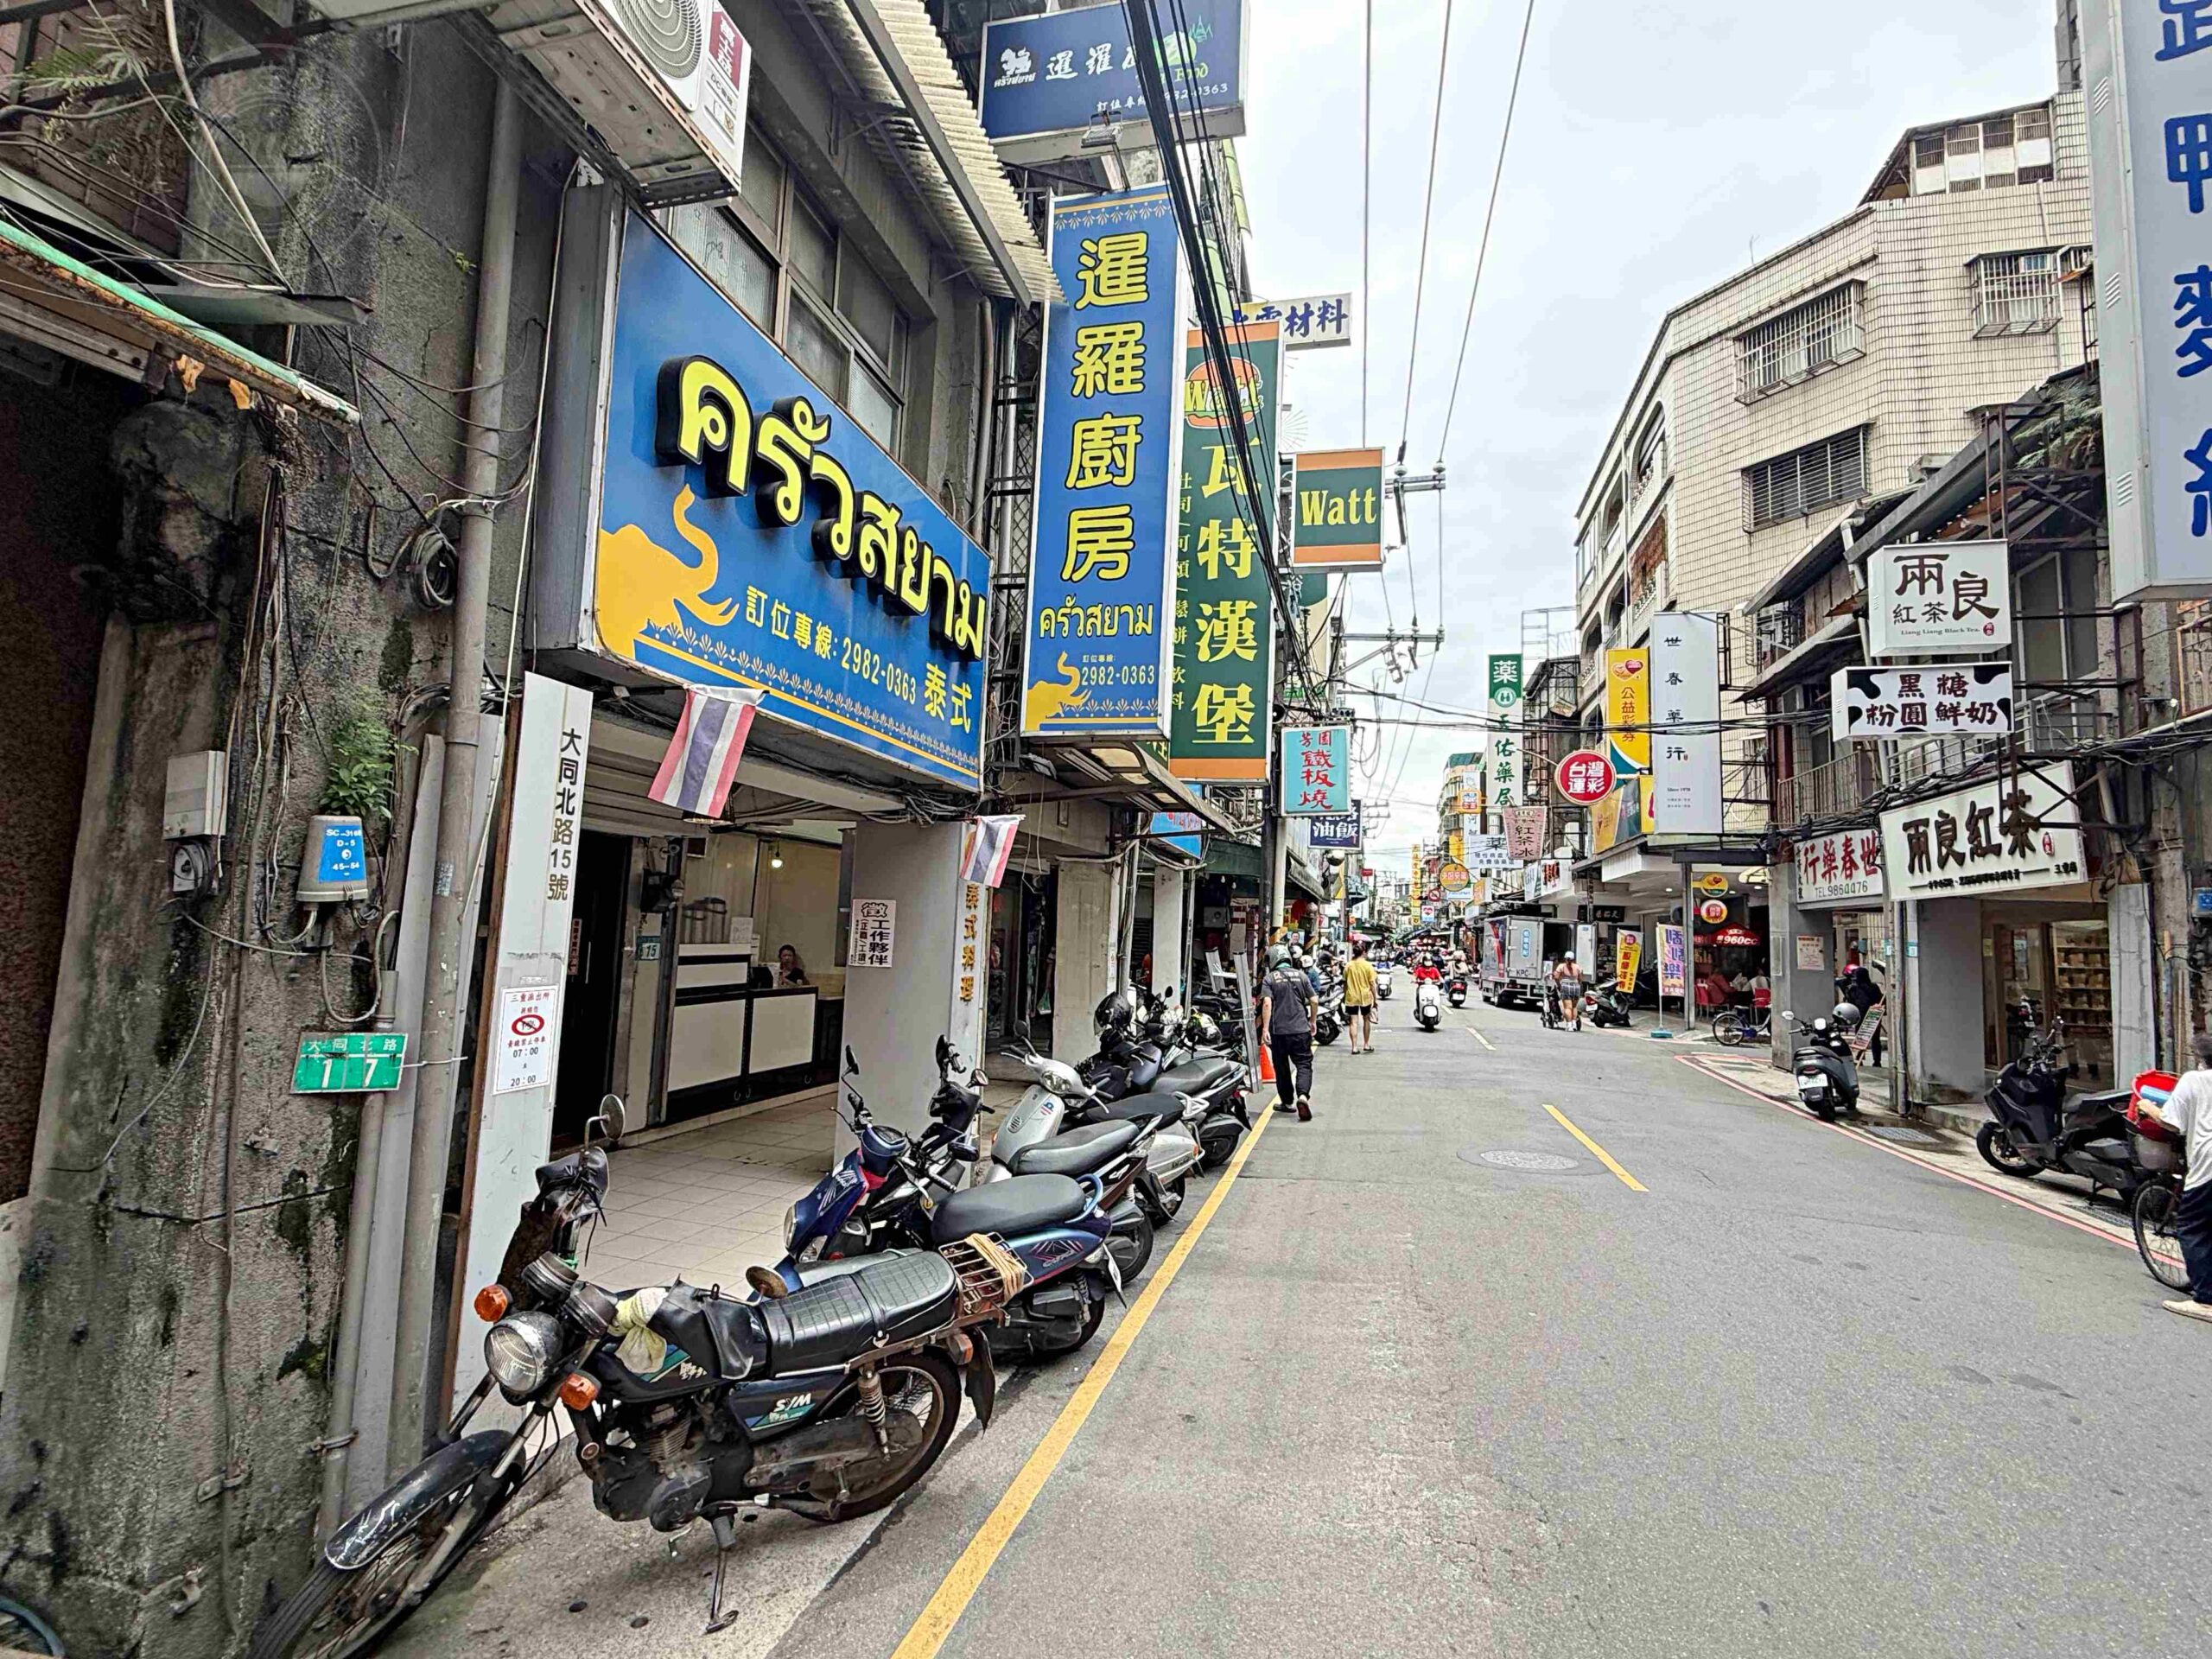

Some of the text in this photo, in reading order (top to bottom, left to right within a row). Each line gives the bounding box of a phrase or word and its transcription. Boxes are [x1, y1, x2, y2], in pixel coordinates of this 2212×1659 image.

[1059, 230, 1149, 583] 暹羅廚房
[674, 354, 988, 658] ครัวสยาม
[1300, 487, 1377, 526] Watt
[1191, 436, 1264, 745] 瓦特漢堡
[1892, 601, 1949, 625] 紅茶
[1039, 593, 1154, 639] ครัวสยาม
[924, 662, 973, 734] 泰式
[1897, 672, 1970, 699] 黑糖
[1865, 701, 1999, 728] 粉圓鮮奶
[1298, 748, 1337, 810] 鐵板燒
[546, 728, 582, 901] 大同北路15號
[1514, 825, 1535, 857] 紅茶冰
[868, 919, 891, 966] 工作夥伴
[773, 1393, 811, 1411] SYM
